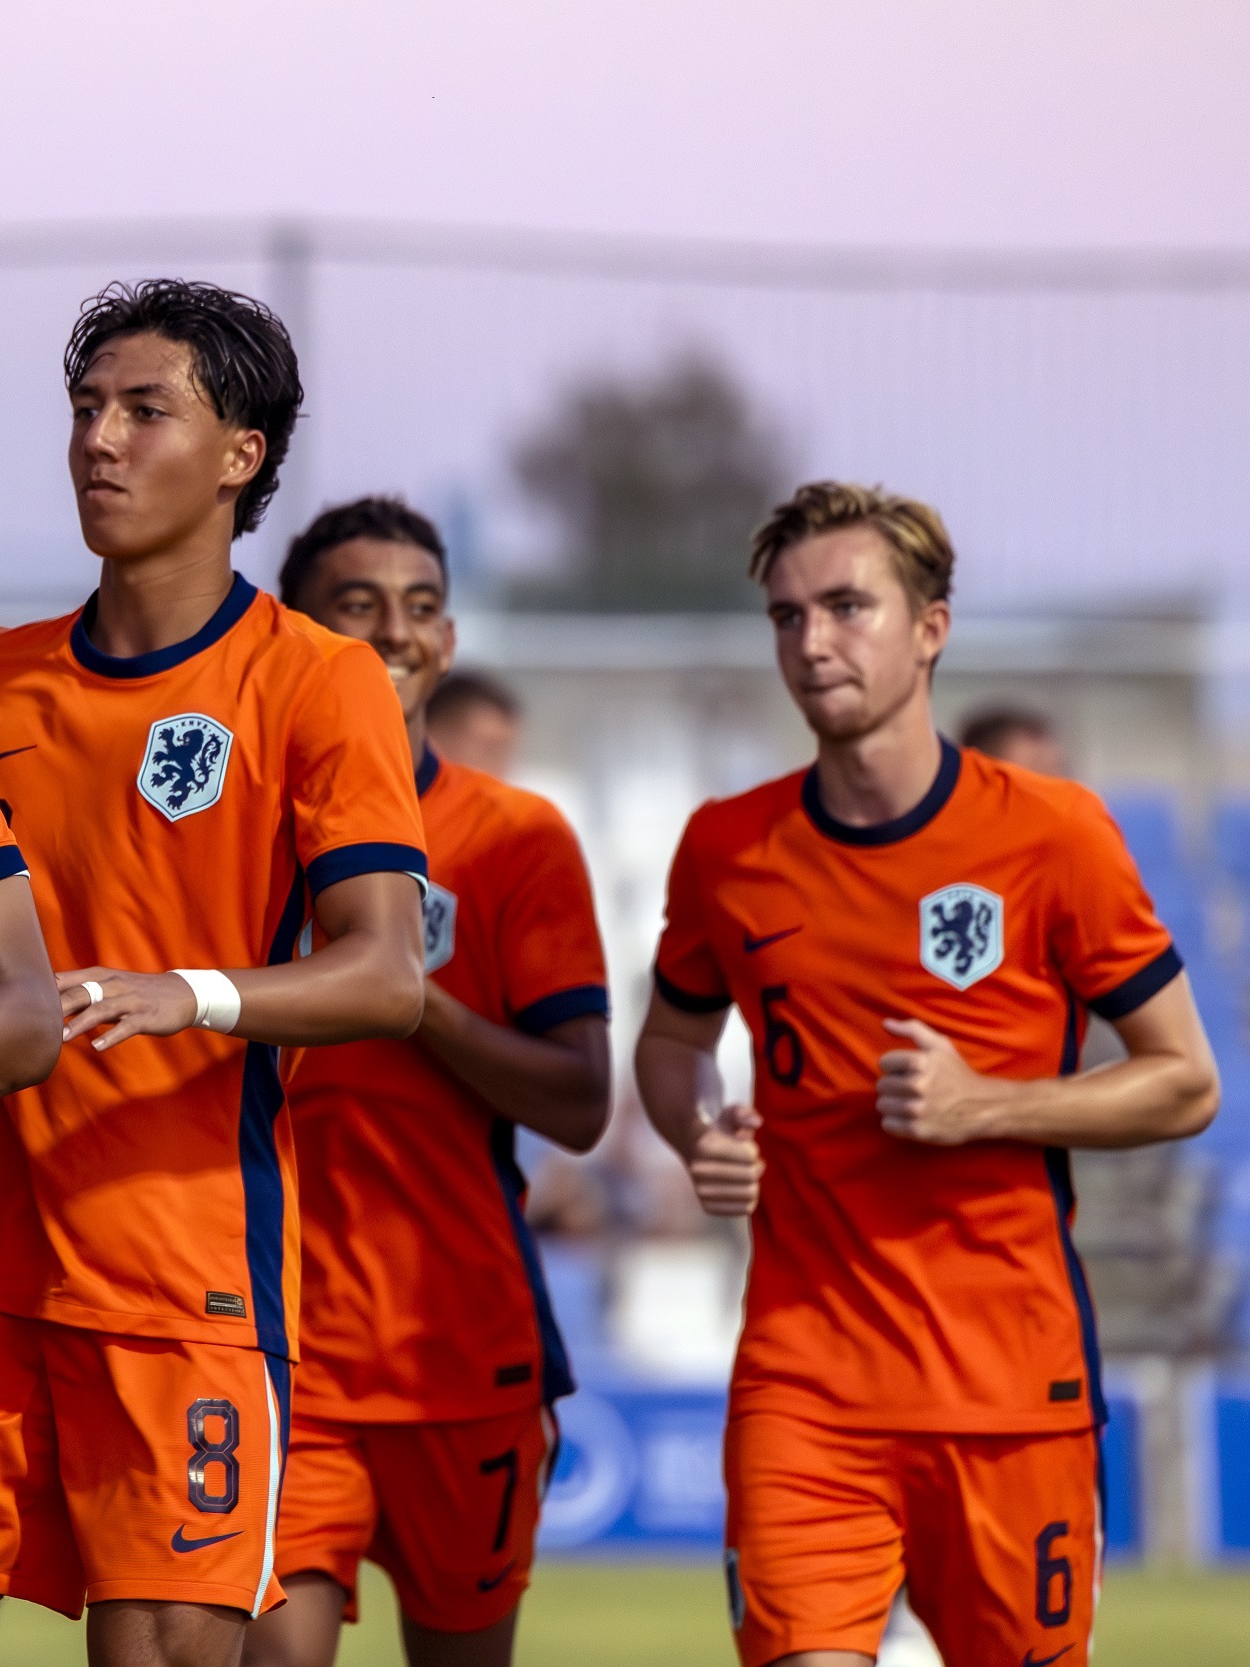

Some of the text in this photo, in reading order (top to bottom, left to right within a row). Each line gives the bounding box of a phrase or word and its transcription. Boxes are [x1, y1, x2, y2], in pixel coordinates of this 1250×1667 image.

[180, 720, 208, 730] KNVB
[761, 985, 804, 1087] 6
[186, 1398, 240, 1514] 8
[479, 1449, 518, 1553] 7
[1034, 1521, 1074, 1628] 6
